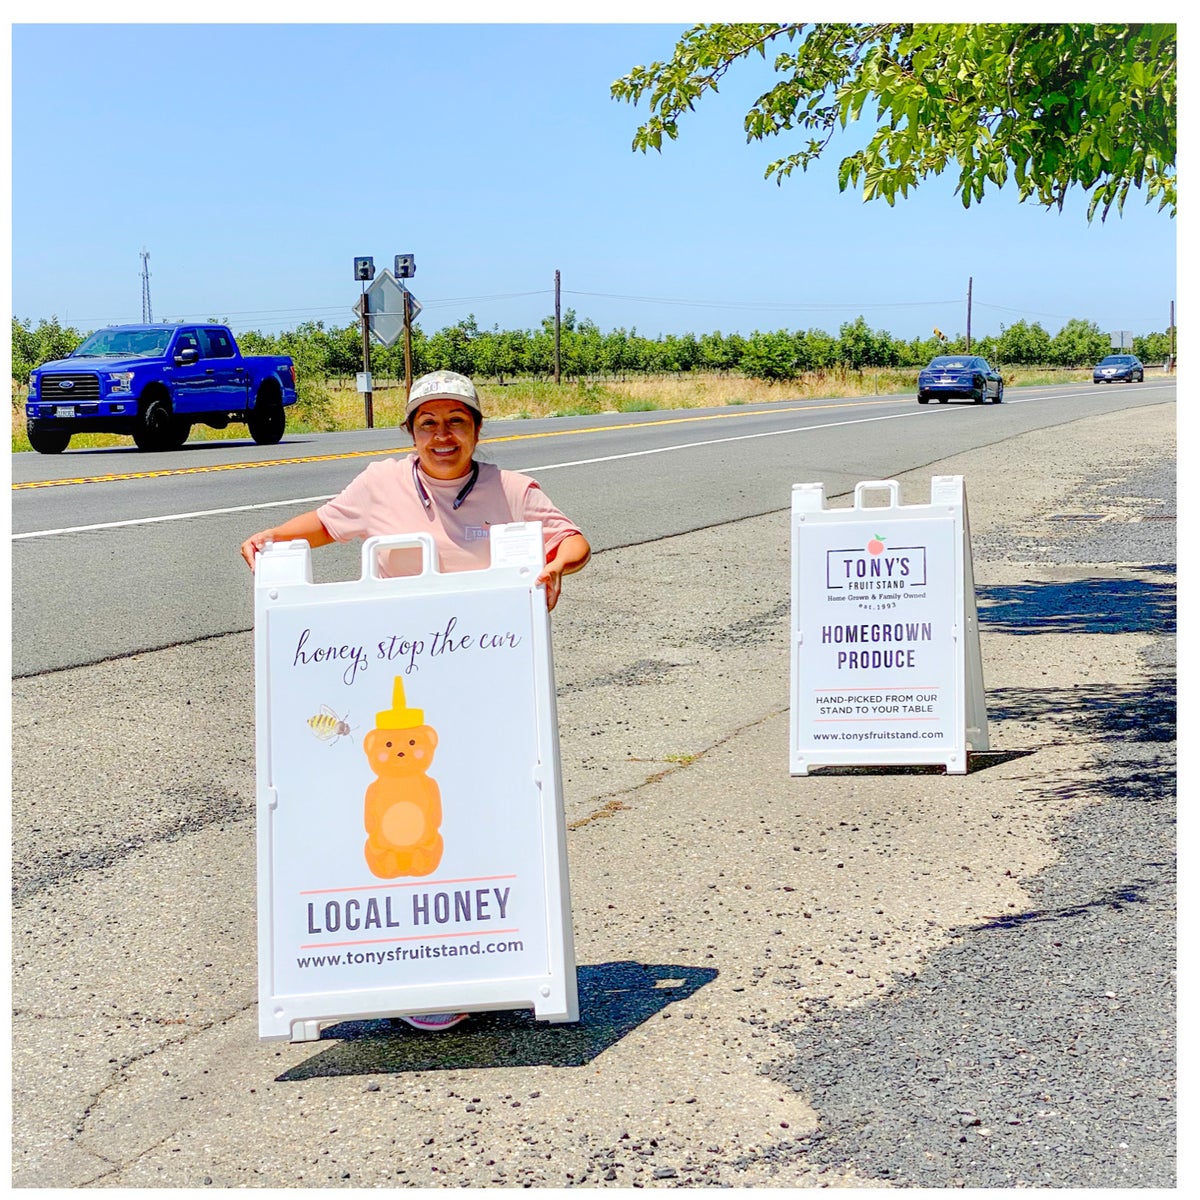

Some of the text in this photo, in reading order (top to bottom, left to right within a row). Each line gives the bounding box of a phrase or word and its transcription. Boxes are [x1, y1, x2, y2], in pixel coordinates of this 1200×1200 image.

[843, 557, 910, 578] TONY'S
[848, 580, 905, 590] FRUIT STAND
[878, 593, 901, 601] Family
[822, 622, 932, 643] HOMEGROWN
[293, 616, 522, 685] honey, stop the car
[838, 650, 915, 669] PRODUCE
[816, 695, 883, 703] HAND-PICKED
[916, 694, 938, 702] OUR
[902, 705, 933, 713] TABLE
[813, 731, 944, 741] www.tonysfruitstand.com
[307, 887, 511, 934] LOCAL HONEY
[297, 940, 524, 968] www.tonysfruitstand.com
